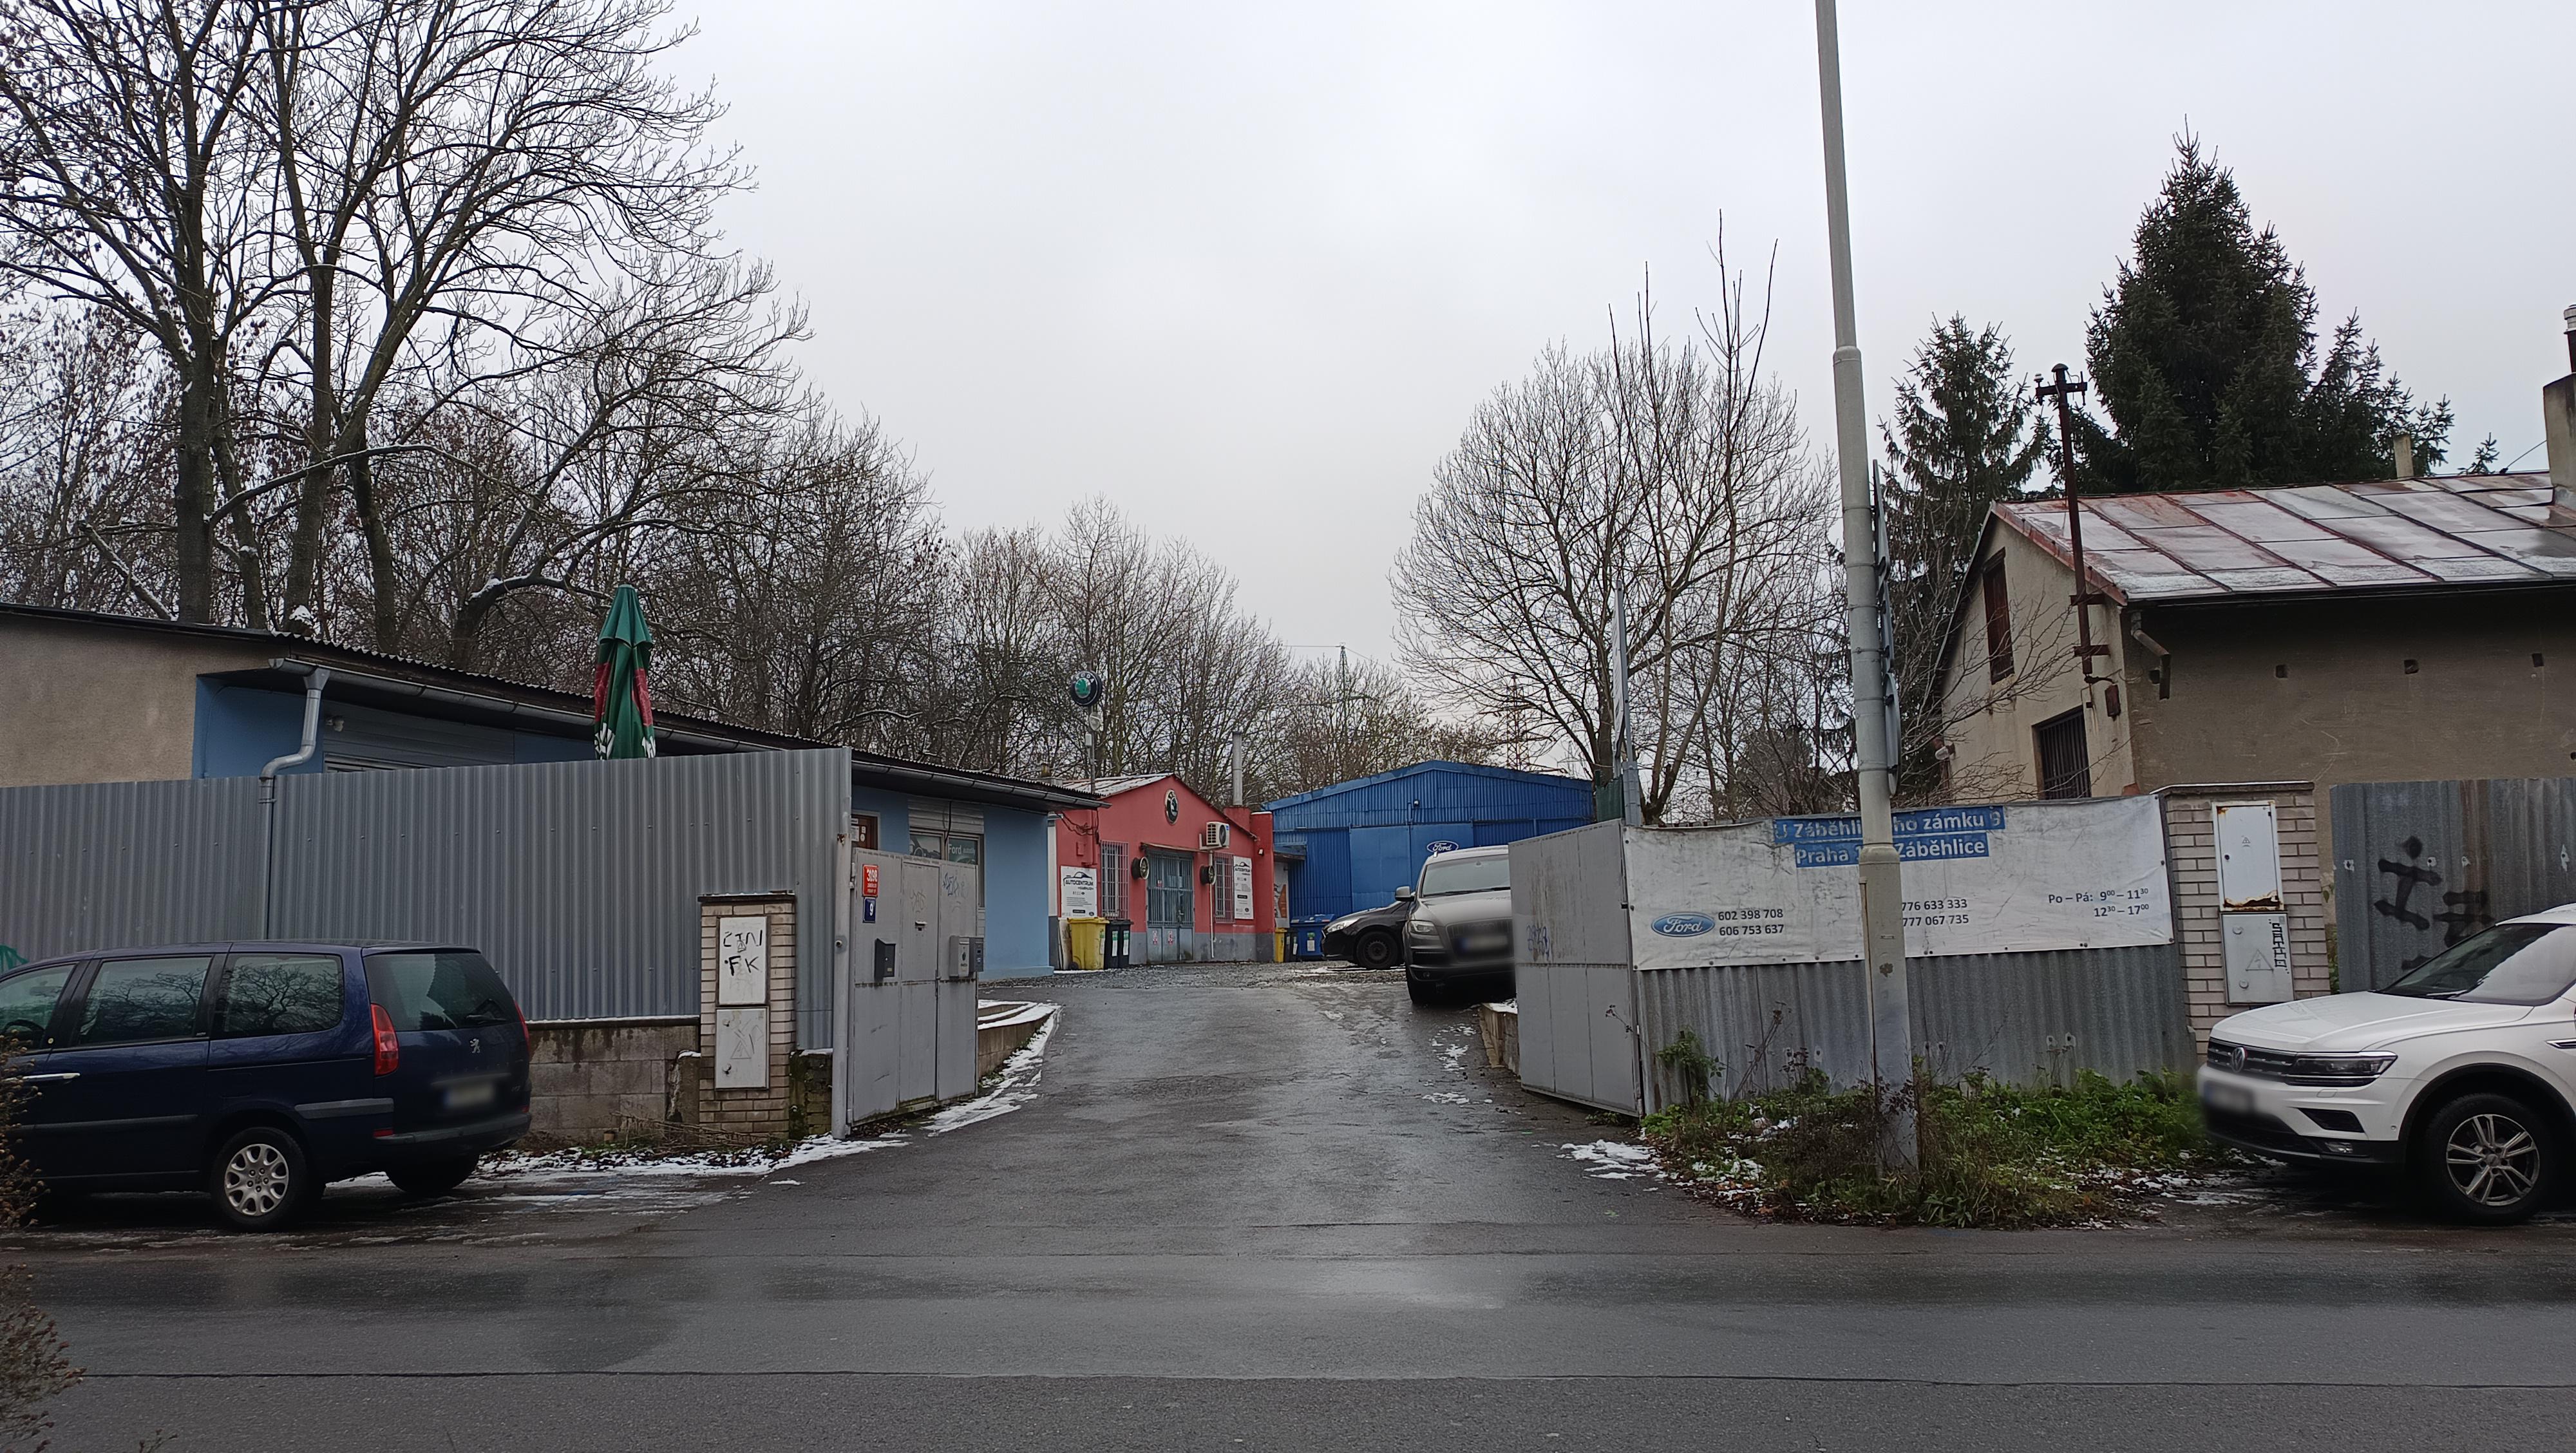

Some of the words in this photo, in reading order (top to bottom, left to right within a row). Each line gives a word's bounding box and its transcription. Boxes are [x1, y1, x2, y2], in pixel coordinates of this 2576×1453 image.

[1794, 817, 1917, 838] Záběhliho
[1923, 811, 1984, 830] zámku
[947, 844, 961, 855] Ford
[1433, 842, 1452, 851] Ford
[1796, 848, 1849, 864] Praha
[1899, 838, 1986, 859] Záběhlice
[2049, 894, 2063, 903] Po
[2076, 892, 2093, 902] Pá:
[869, 903, 874, 916] 9
[1902, 902, 1920, 911] 776
[1924, 900, 1944, 909] 633
[1947, 898, 1967, 909] 333
[1718, 911, 1738, 920] 602
[1741, 909, 1761, 920] 398
[1763, 908, 1784, 918] 708
[1663, 915, 1703, 933] Ford
[1902, 917, 1922, 927] 777
[1925, 916, 1945, 926] 067
[1948, 915, 1969, 924] 735
[1719, 926, 1739, 936] 606
[1741, 925, 1762, 935] 753
[1765, 924, 1784, 934] 637
